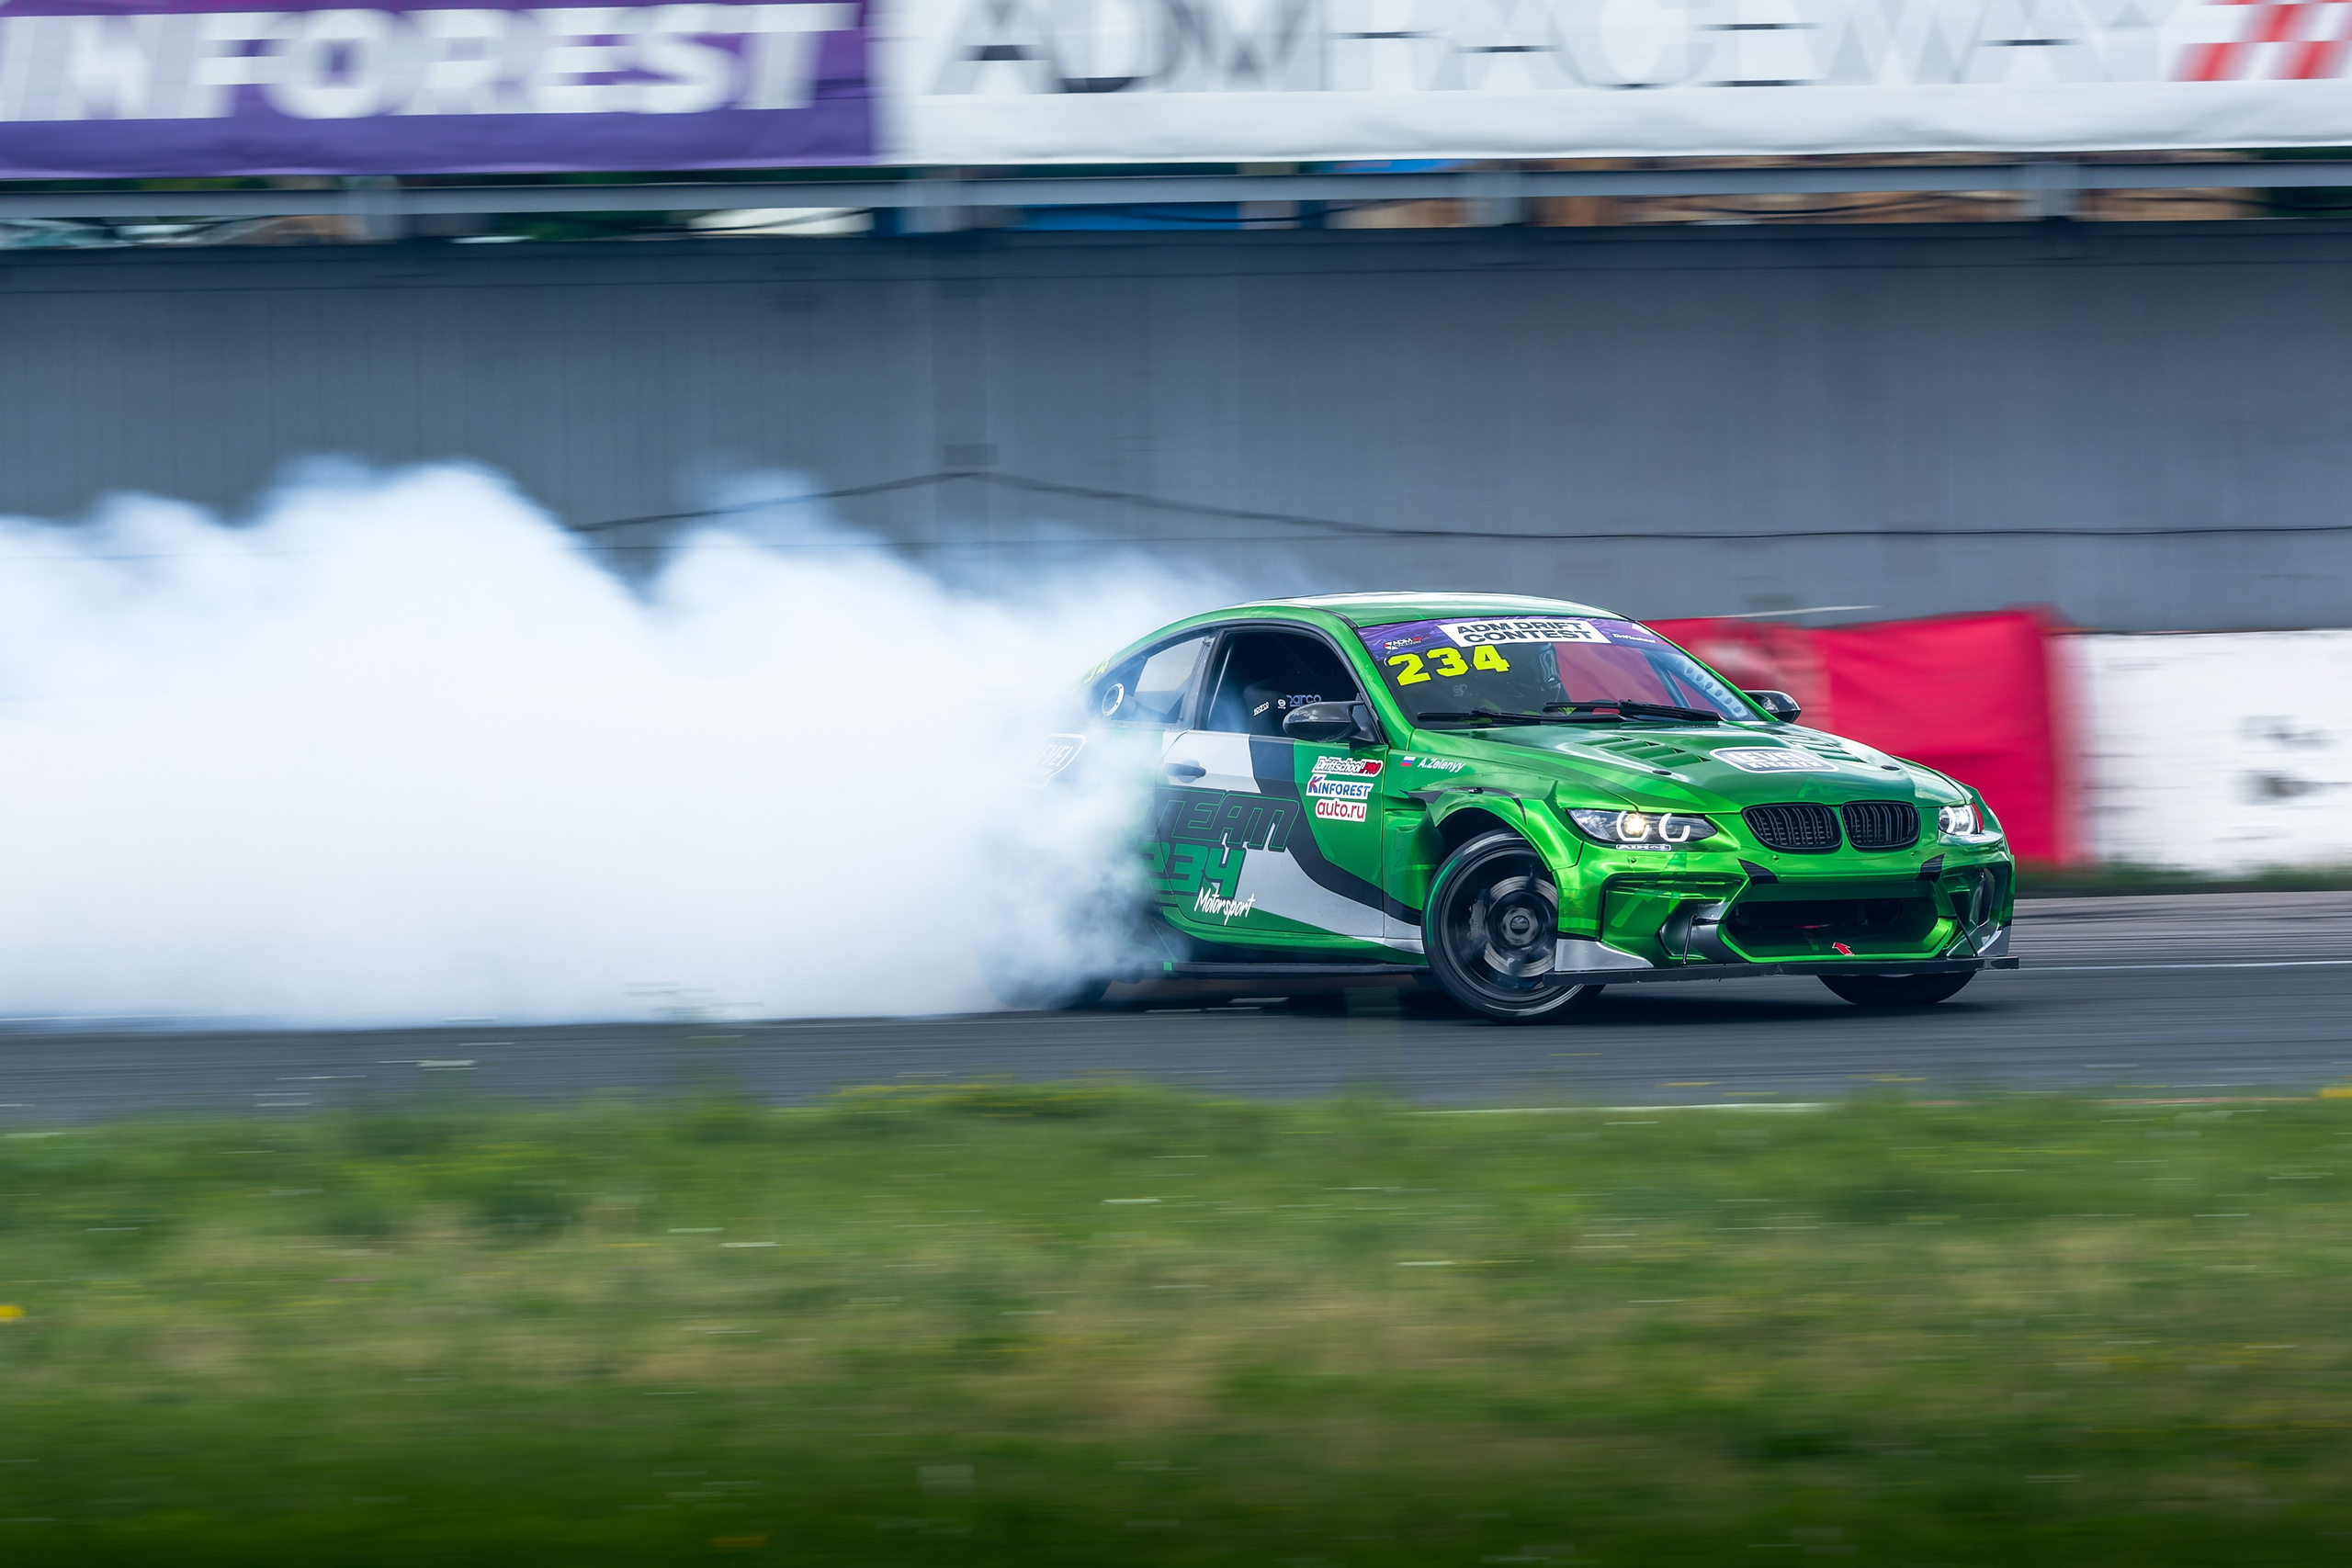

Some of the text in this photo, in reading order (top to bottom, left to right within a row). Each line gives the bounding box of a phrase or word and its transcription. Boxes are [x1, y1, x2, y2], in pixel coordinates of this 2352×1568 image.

[1457, 621, 1583, 635] ADM DRIFT
[1464, 630, 1592, 642] CONTEST
[1387, 645, 1510, 686] 234
[1286, 694, 1322, 707] parco
[1418, 758, 1465, 773] A.Zelenyy
[1308, 776, 1370, 796] KINFOREST
[1317, 801, 1364, 818] auto.ru
[1194, 887, 1256, 926] Motorsport
